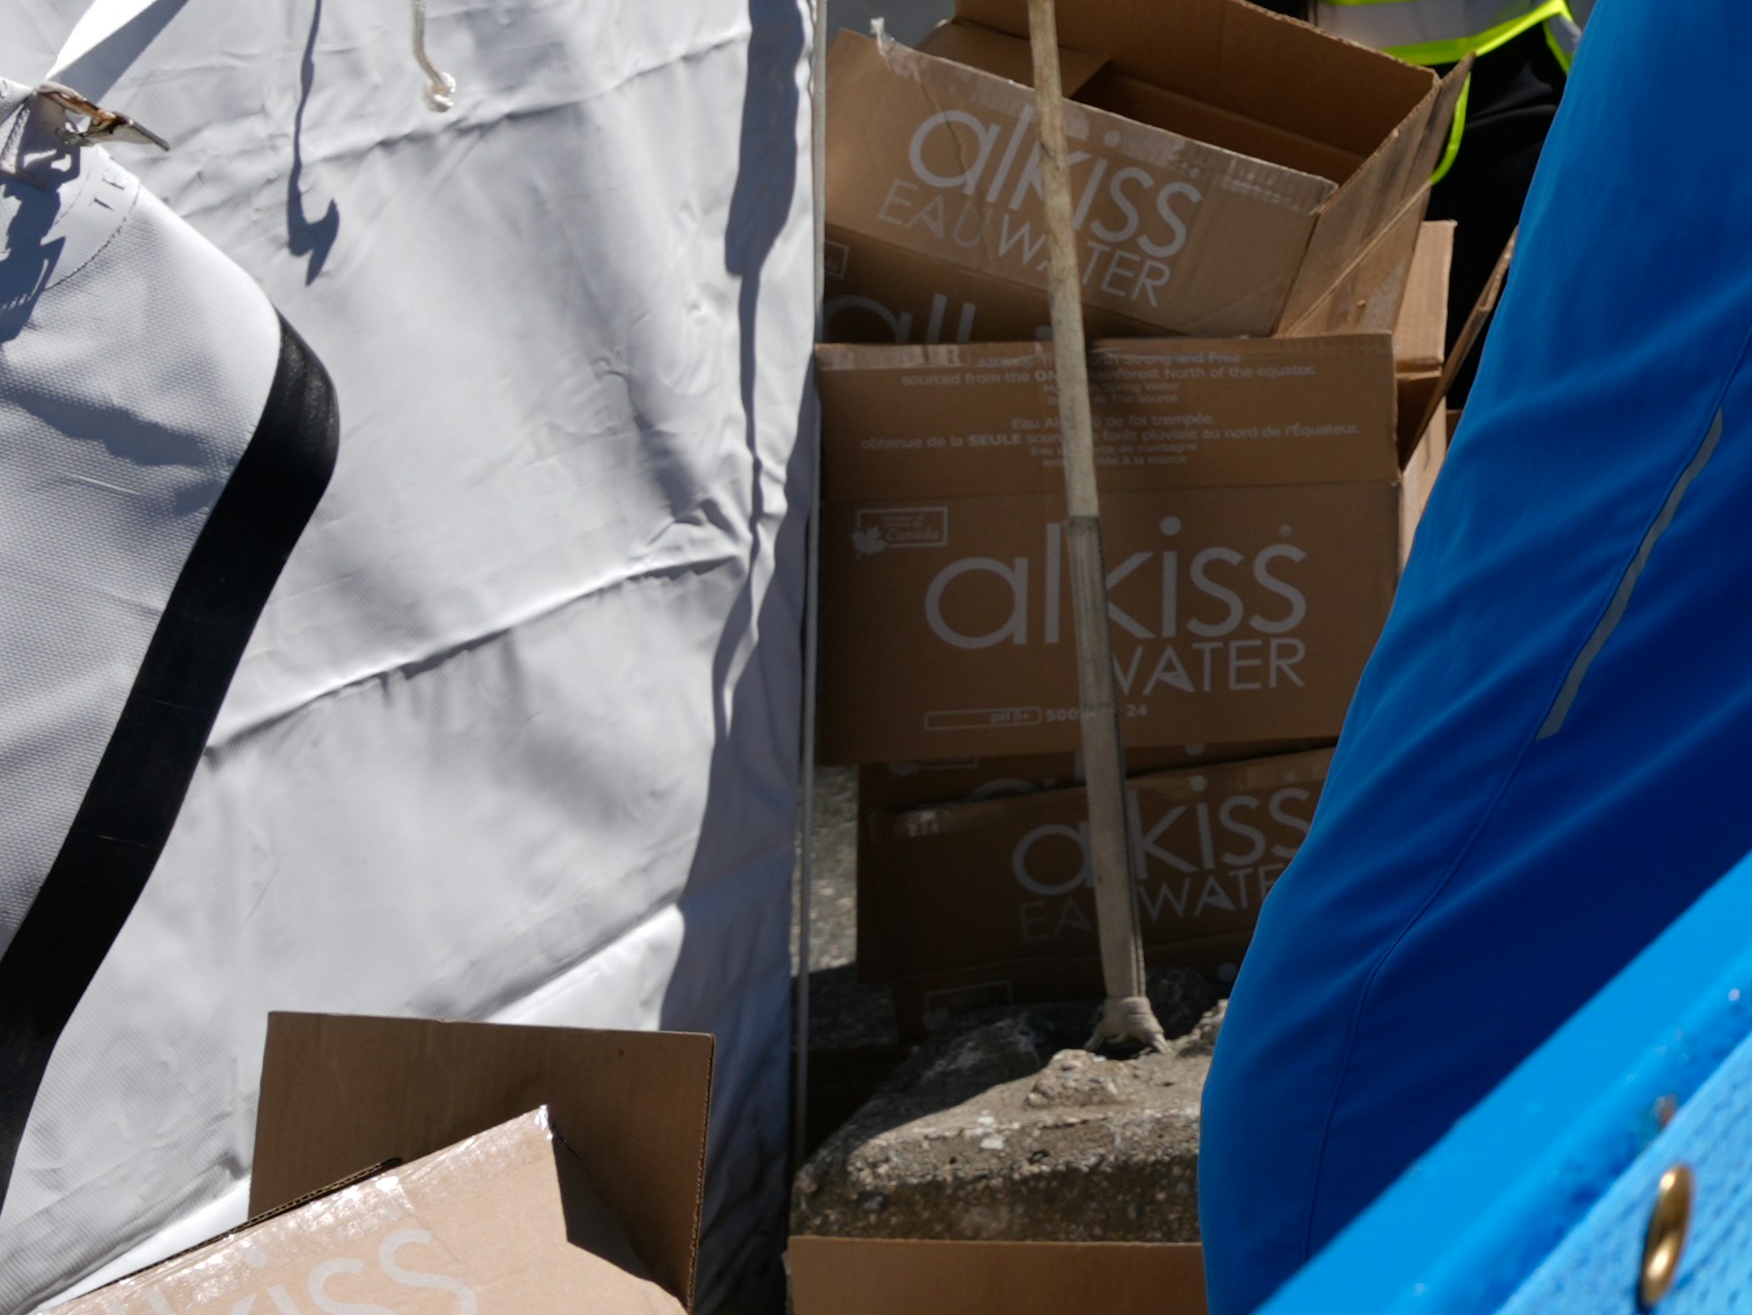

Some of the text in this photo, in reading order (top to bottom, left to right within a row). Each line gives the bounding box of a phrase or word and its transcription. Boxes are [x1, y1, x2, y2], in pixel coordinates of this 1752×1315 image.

[1123, 352, 1172, 367] Strong
[1177, 352, 1204, 364] and
[1209, 352, 1242, 364] Free
[902, 373, 960, 386] sourced
[964, 371, 1000, 385] from
[1005, 371, 1030, 383] the
[1164, 366, 1206, 379] North
[1209, 365, 1225, 379] of
[1229, 365, 1254, 378] the
[1259, 364, 1316, 380] equator.
[1138, 393, 1178, 404] Source
[1012, 416, 1039, 430] Eau
[1105, 415, 1125, 427] de
[1151, 413, 1214, 428] trempée
[860, 436, 923, 450] obtenue
[926, 434, 946, 448] de
[950, 434, 964, 447] la
[967, 433, 1023, 447] SEULE
[1142, 427, 1198, 443] pluviale
[1202, 427, 1220, 440] au
[1225, 426, 1258, 439] nord
[1263, 424, 1281, 438] de
[925, 516, 1308, 649] alkiss
[1125, 704, 1149, 717] 24
[1012, 775, 1312, 895] akiss
[1019, 898, 1094, 943] EA
